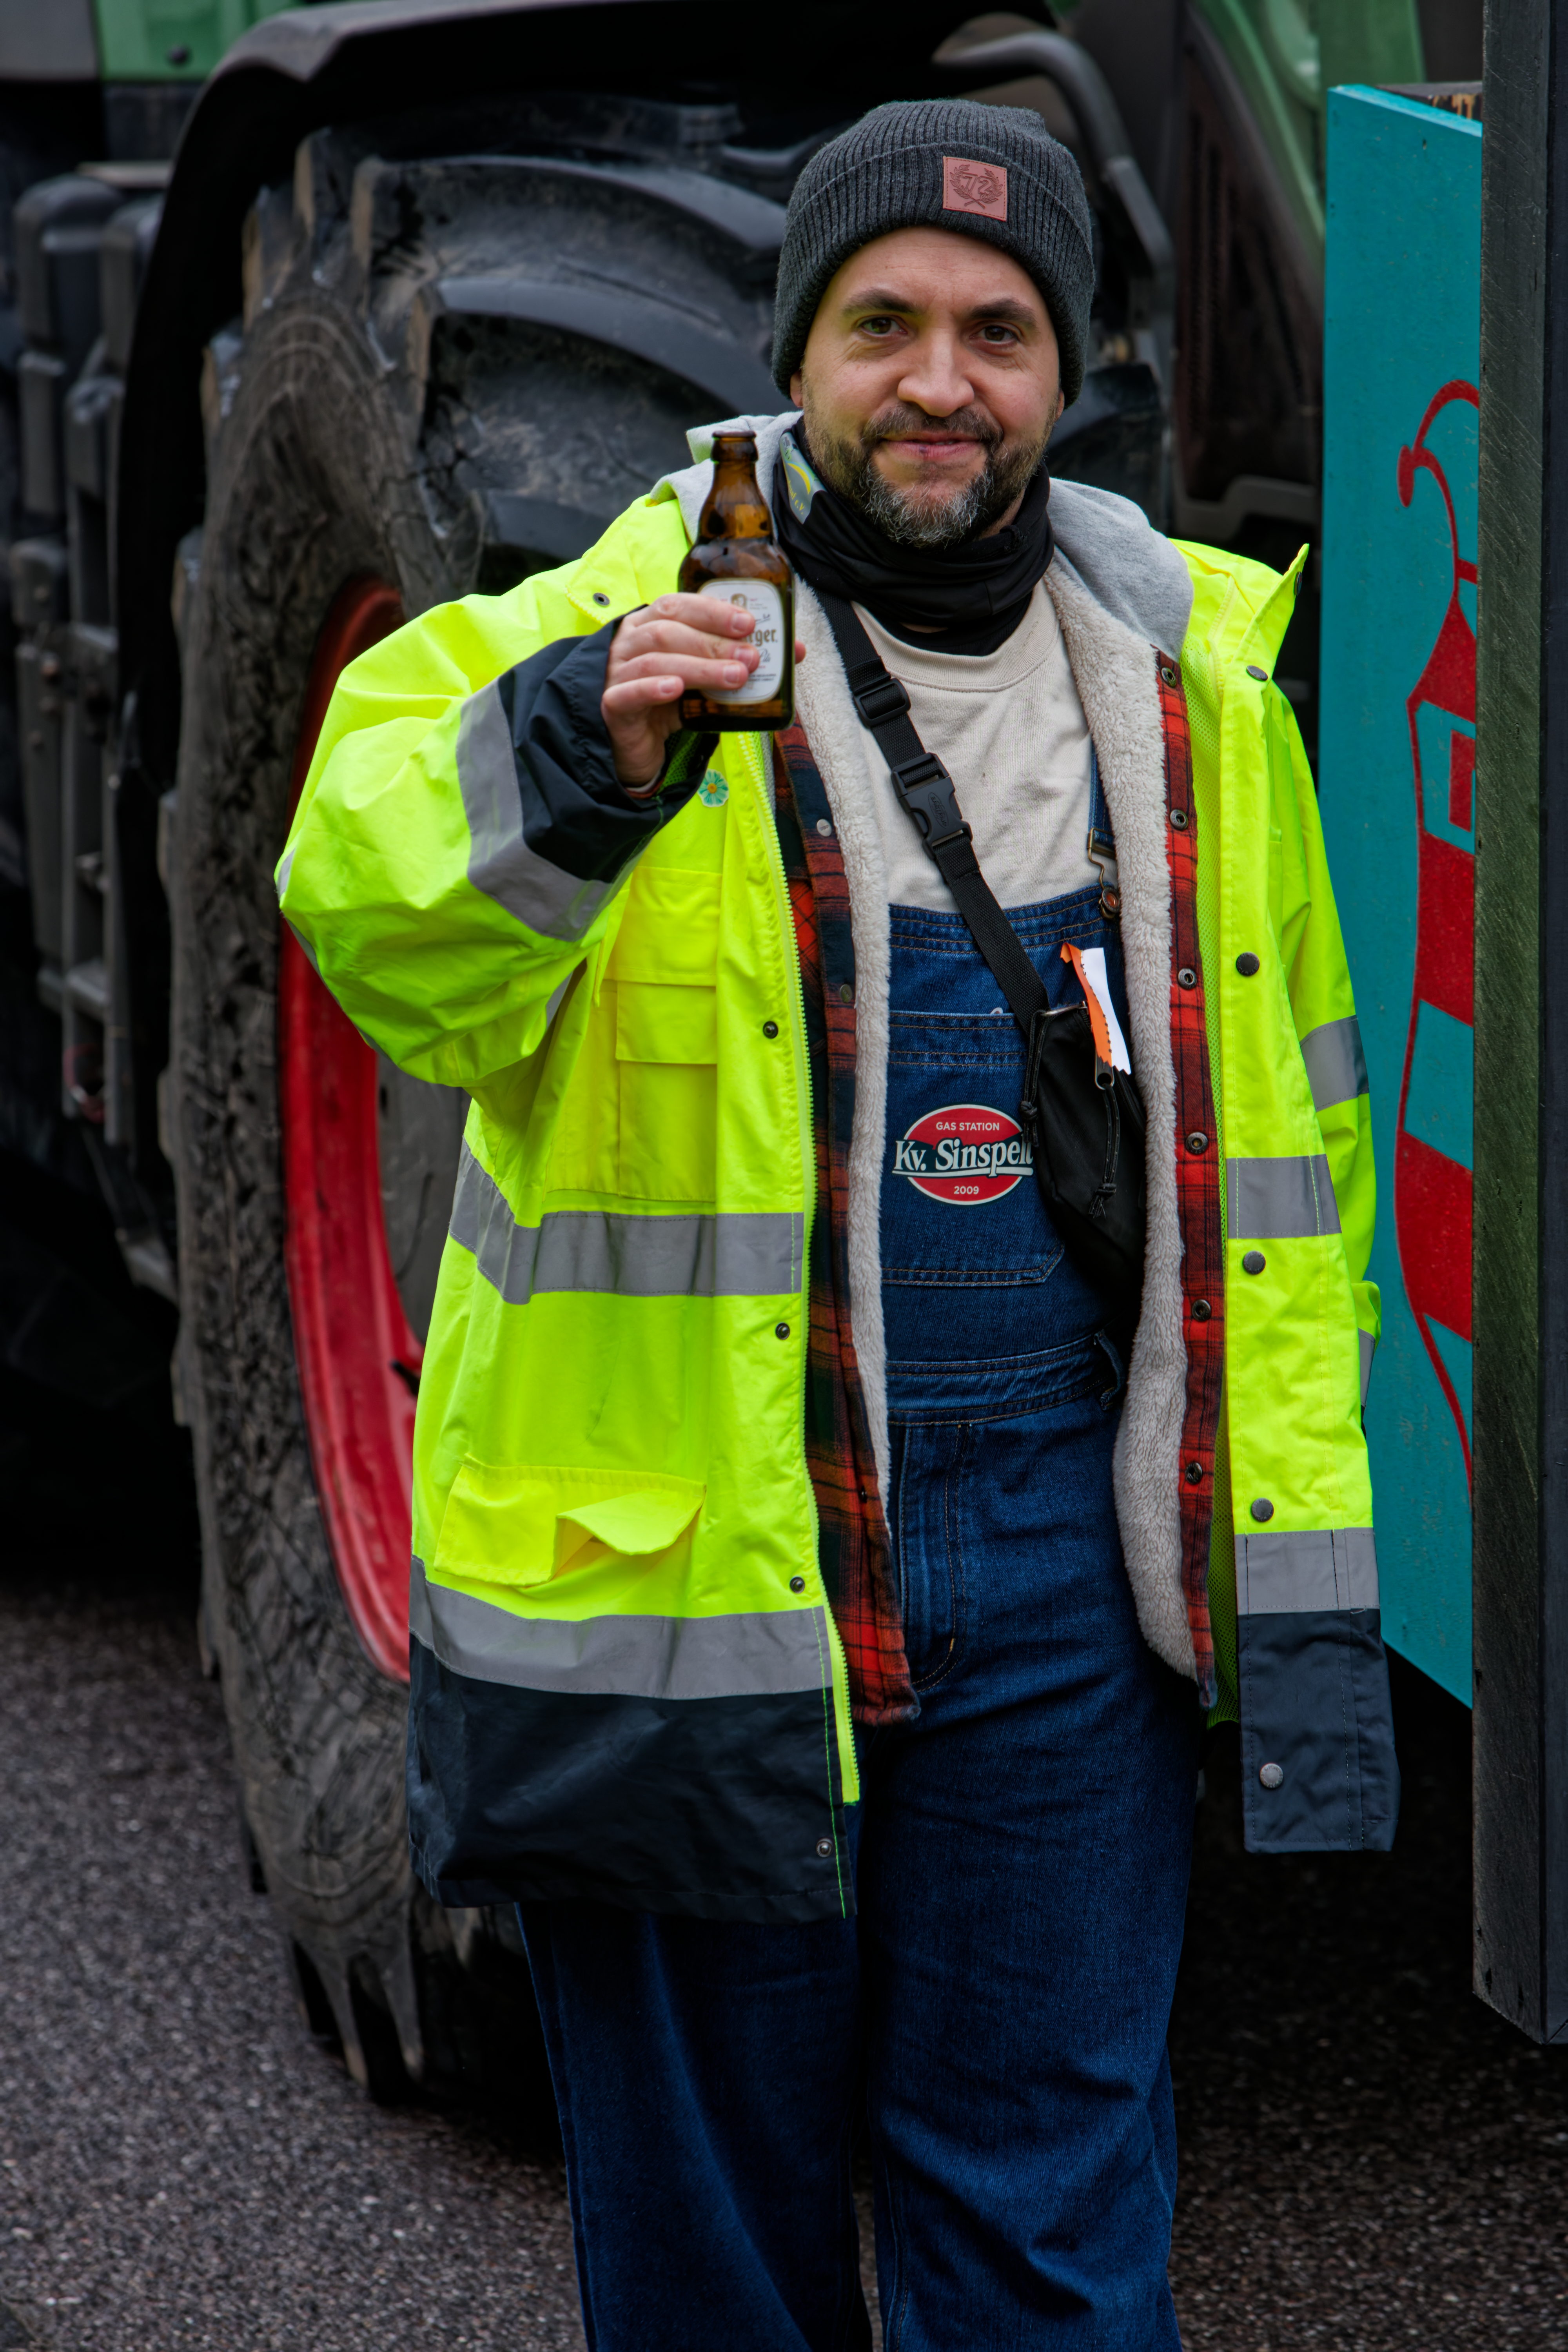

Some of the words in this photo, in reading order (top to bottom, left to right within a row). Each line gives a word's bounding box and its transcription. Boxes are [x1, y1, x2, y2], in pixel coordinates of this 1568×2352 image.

[936, 1122, 956, 1131] GAS
[959, 1122, 1000, 1131] STATION
[894, 1140, 927, 1171] Kv.
[954, 1185, 979, 1195] 2009
